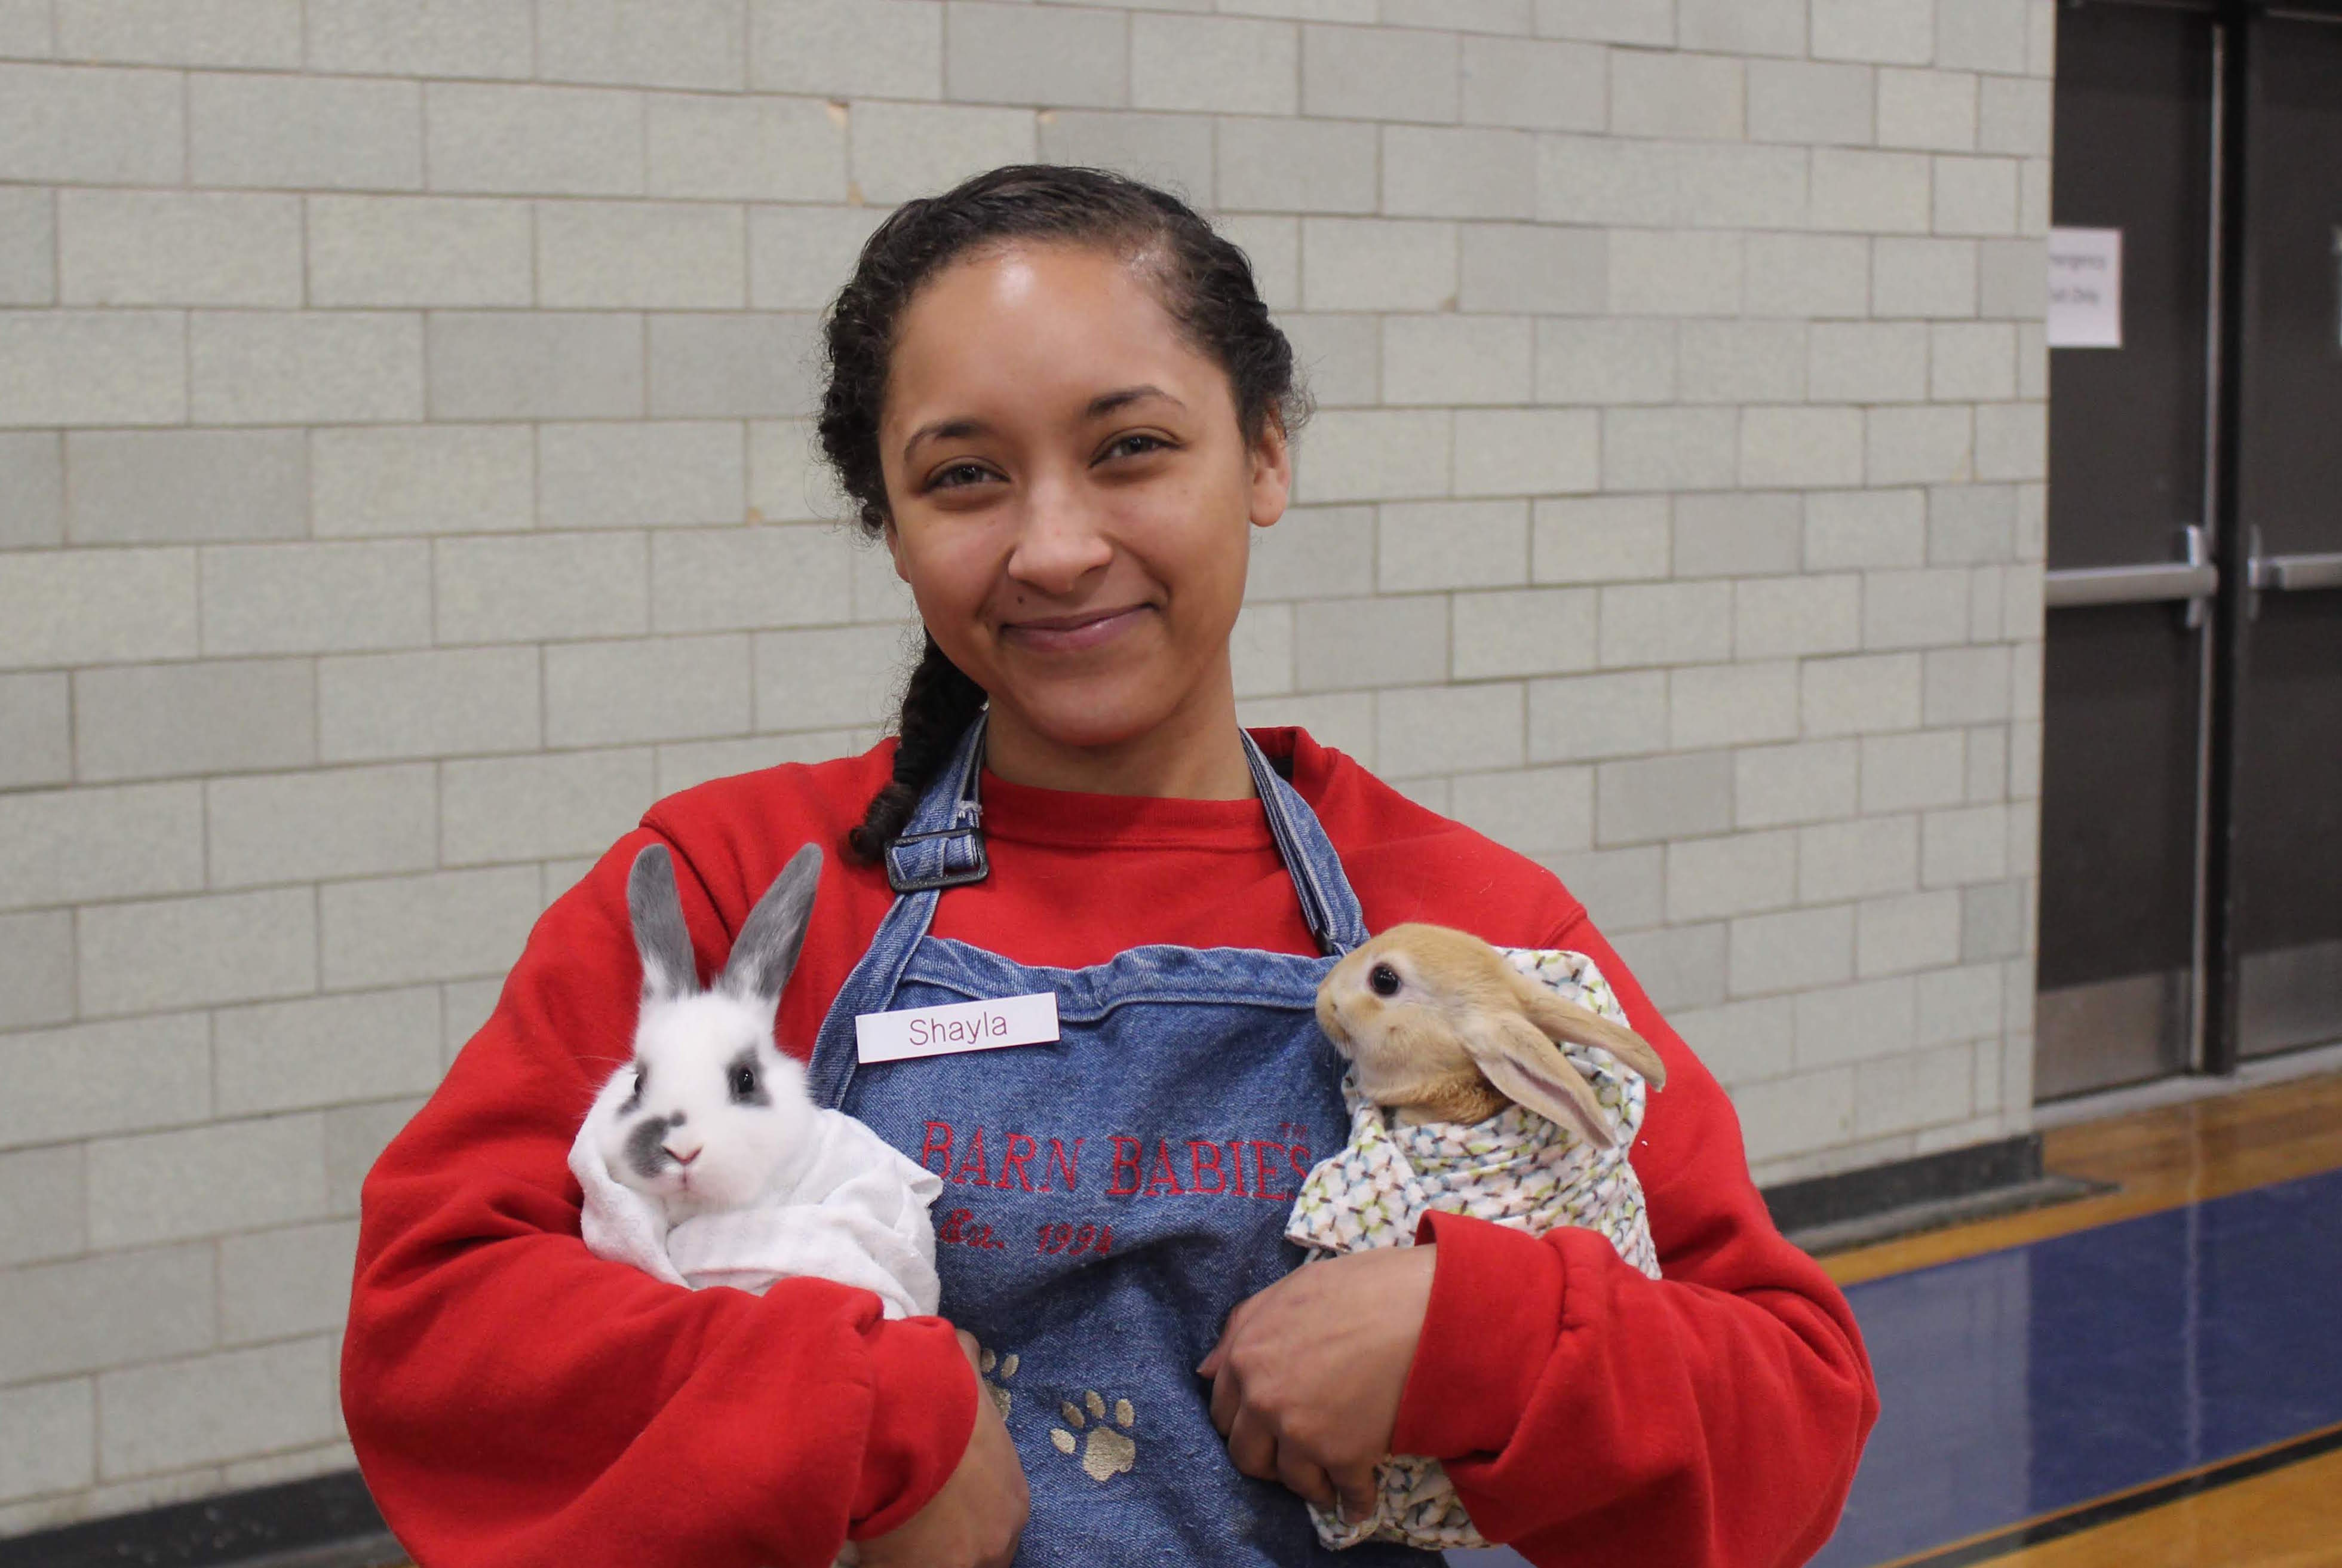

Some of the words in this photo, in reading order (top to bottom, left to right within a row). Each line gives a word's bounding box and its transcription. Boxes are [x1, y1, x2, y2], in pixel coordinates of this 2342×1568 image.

[910, 1011, 1008, 1045] Shayla
[921, 1120, 1086, 1193] BARN
[1106, 1136, 1311, 1201] BABIES
[1036, 1223, 1113, 1256] 1994
